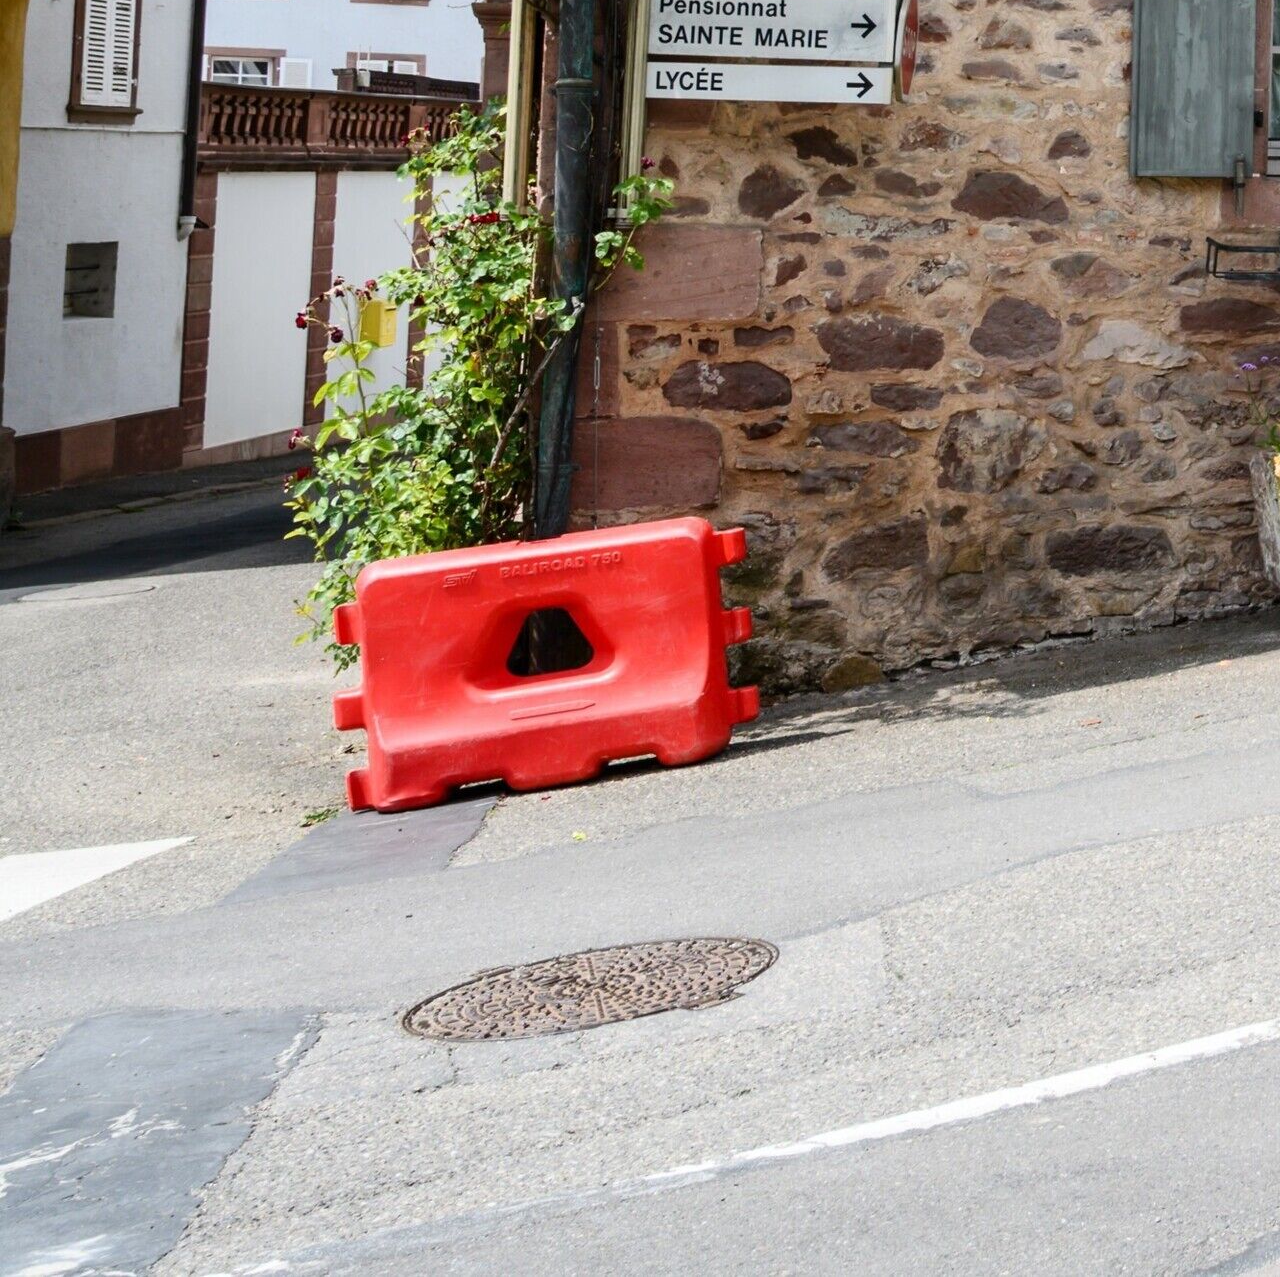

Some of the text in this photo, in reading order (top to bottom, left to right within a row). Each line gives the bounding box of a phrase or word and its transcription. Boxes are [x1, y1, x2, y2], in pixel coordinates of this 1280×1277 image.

[657, 24, 829, 49] SAINTE MARIE
[655, 68, 724, 91] LYCÉE
